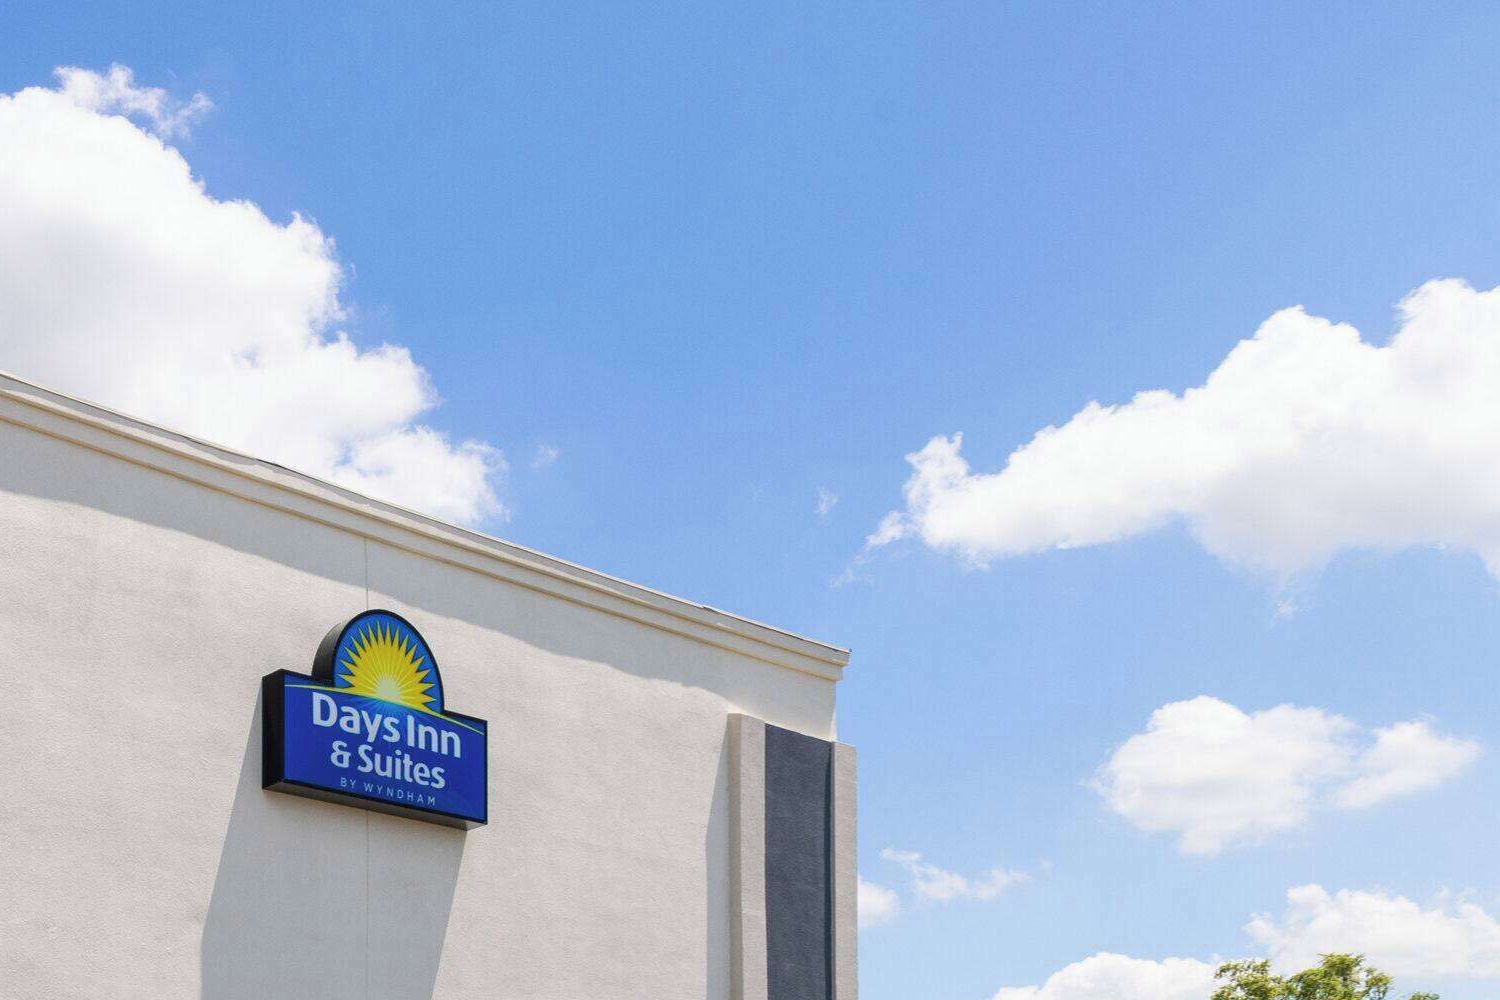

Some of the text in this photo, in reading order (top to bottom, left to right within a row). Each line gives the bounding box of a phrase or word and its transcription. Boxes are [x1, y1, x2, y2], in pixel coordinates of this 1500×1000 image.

[312, 692, 461, 758] Days Inn
[330, 740, 446, 789] & Suites
[340, 777, 436, 806] BY WYNDHAM
